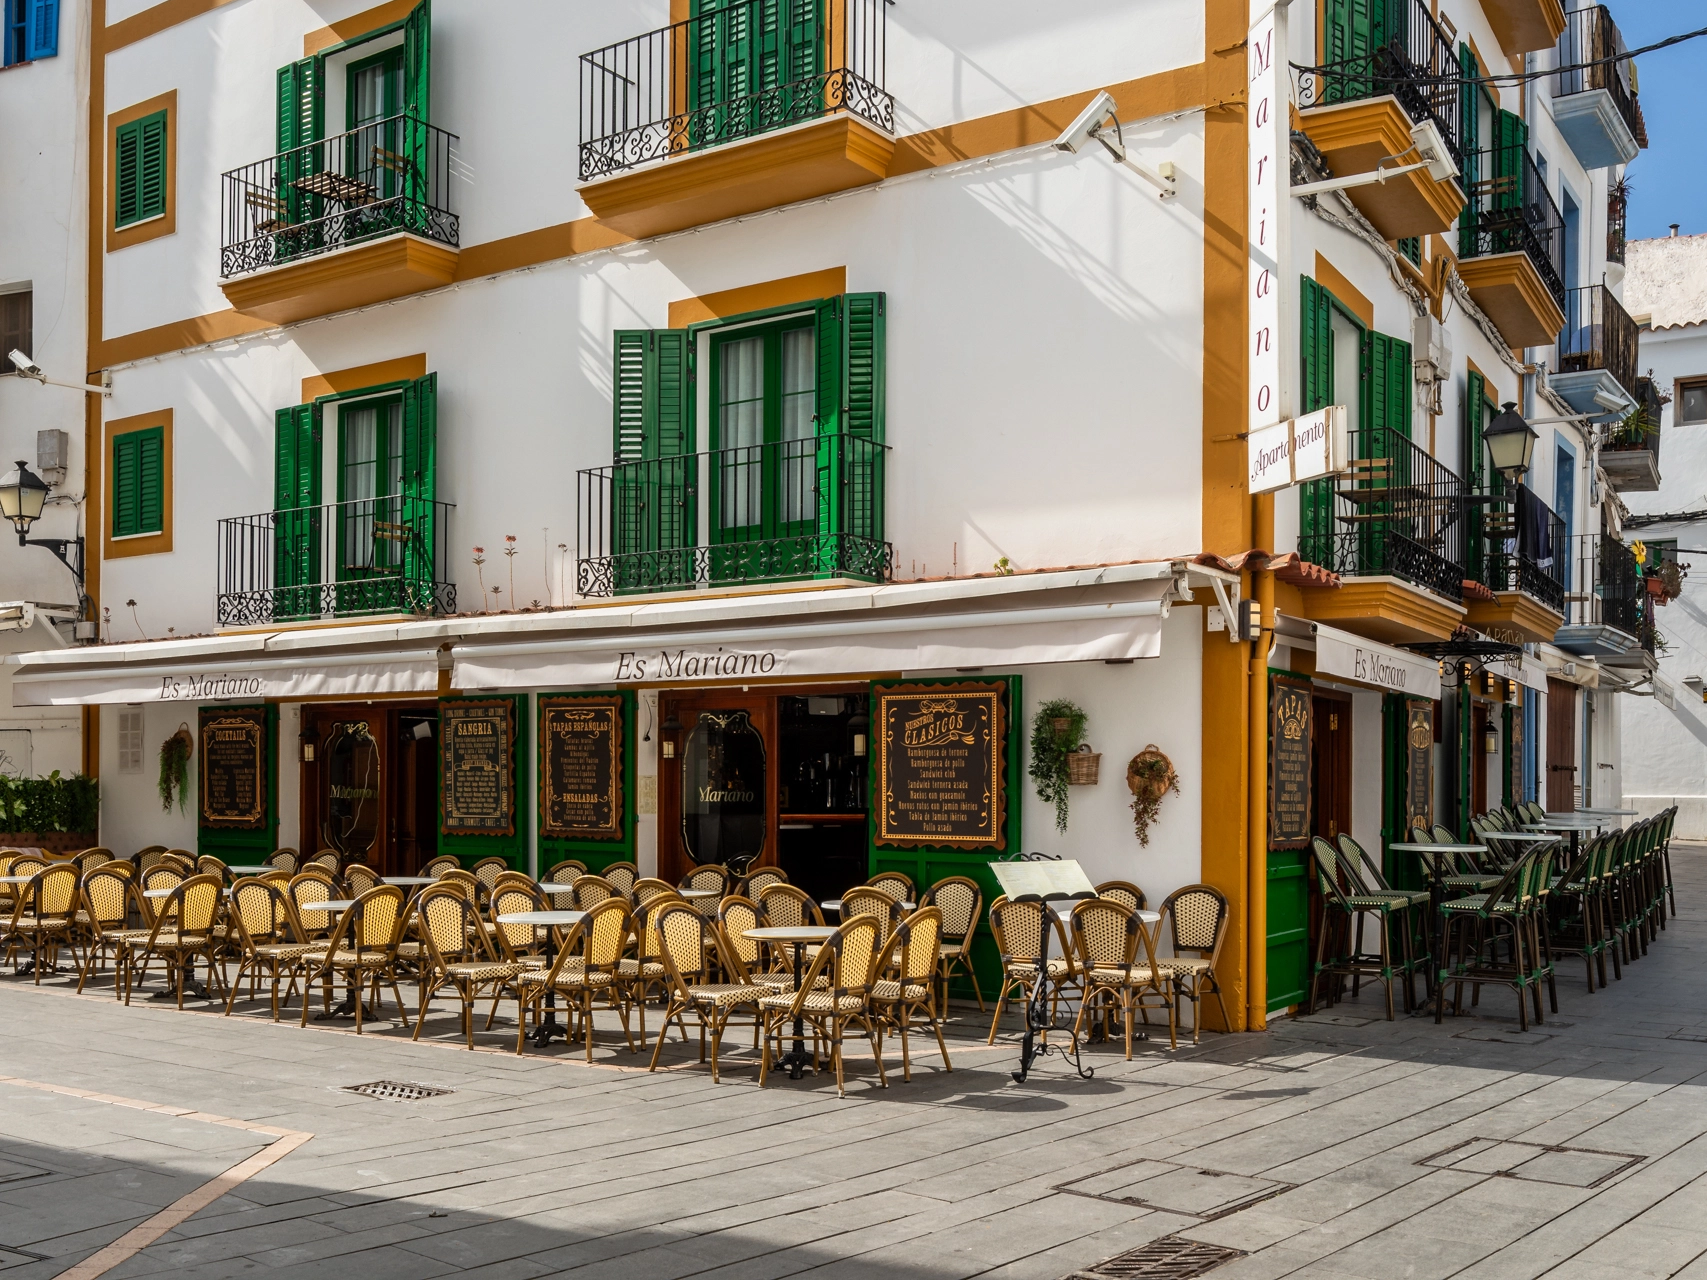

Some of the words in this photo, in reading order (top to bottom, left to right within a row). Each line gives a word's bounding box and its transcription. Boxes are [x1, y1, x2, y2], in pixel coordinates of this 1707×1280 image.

[1251, 28, 1273, 412] Mariano
[614, 652, 646, 680] Es
[656, 646, 776, 678] Mariano
[1354, 649, 1367, 680] Es
[1370, 653, 1407, 688] Mariano
[160, 677, 180, 699] Es
[186, 673, 260, 698] Mariano
[1278, 695, 1308, 729] TAPAS
[553, 722, 572, 731] TAPAS
[574, 720, 607, 731] ESPAÑOLAS
[905, 714, 934, 730] NUESTROS
[458, 723, 492, 735] SANGRIA
[905, 715, 963, 744] CLASICOS
[216, 730, 246, 741] COCKTAILS
[908, 748, 939, 758] Hamburguesa
[941, 748, 947, 756] de
[949, 748, 968, 756] ternera
[911, 758, 942, 768] Hamburguesa
[945, 759, 950, 767] de
[952, 759, 964, 768] pollo
[920, 769, 942, 778] Sandwich
[945, 769, 955, 778] club
[908, 780, 930, 788] Sandwich
[932, 780, 951, 788] ternera
[953, 780, 968, 788] asada
[563, 794, 598, 803] ENSALADAS
[699, 786, 754, 802] Mariano
[910, 791, 927, 799] Nachos
[939, 791, 965, 800] guacamole
[931, 802, 939, 810] con
[909, 811, 923, 820] Tabla
[925, 812, 930, 820] de
[923, 823, 936, 831] Pollo
[937, 823, 952, 831] asado
